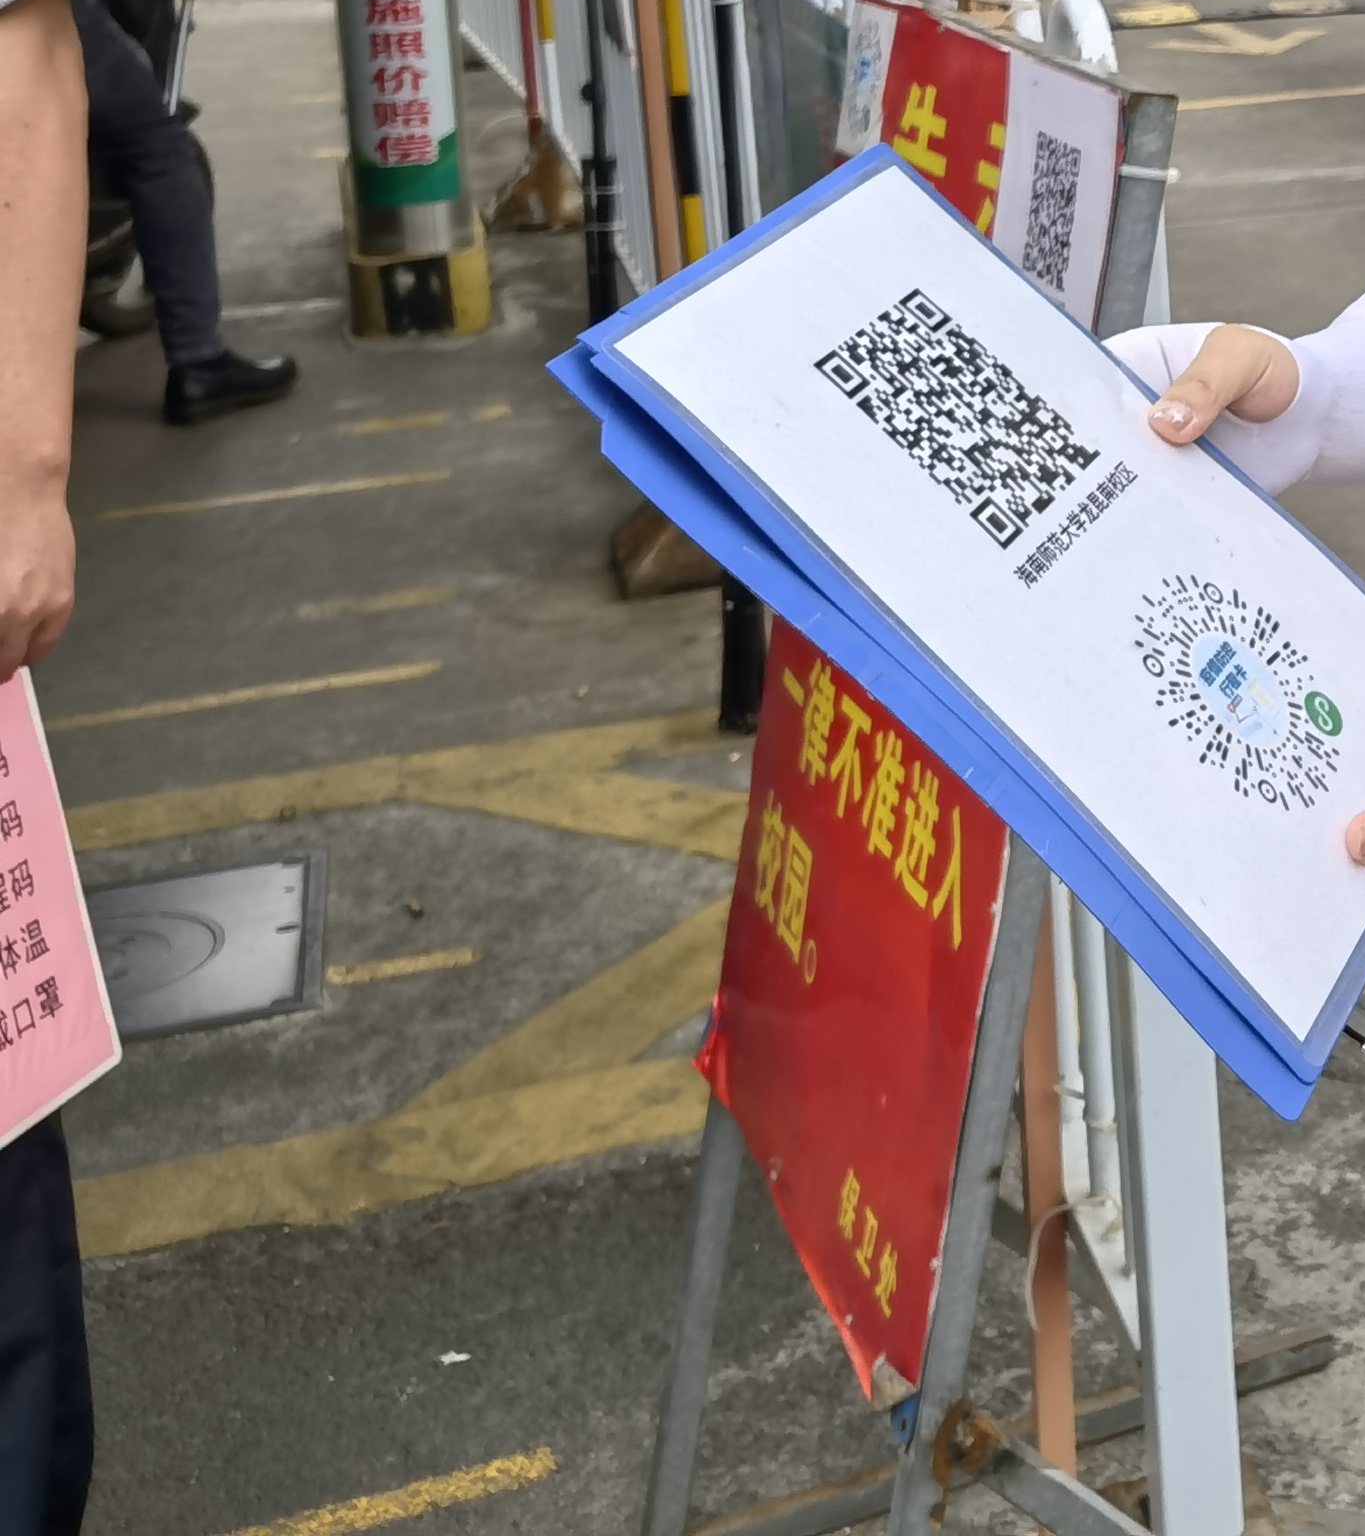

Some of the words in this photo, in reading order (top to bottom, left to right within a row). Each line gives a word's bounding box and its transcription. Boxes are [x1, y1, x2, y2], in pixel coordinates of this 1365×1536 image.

[1013, 460, 1139, 590] 海南师范大学龙昆南校区
